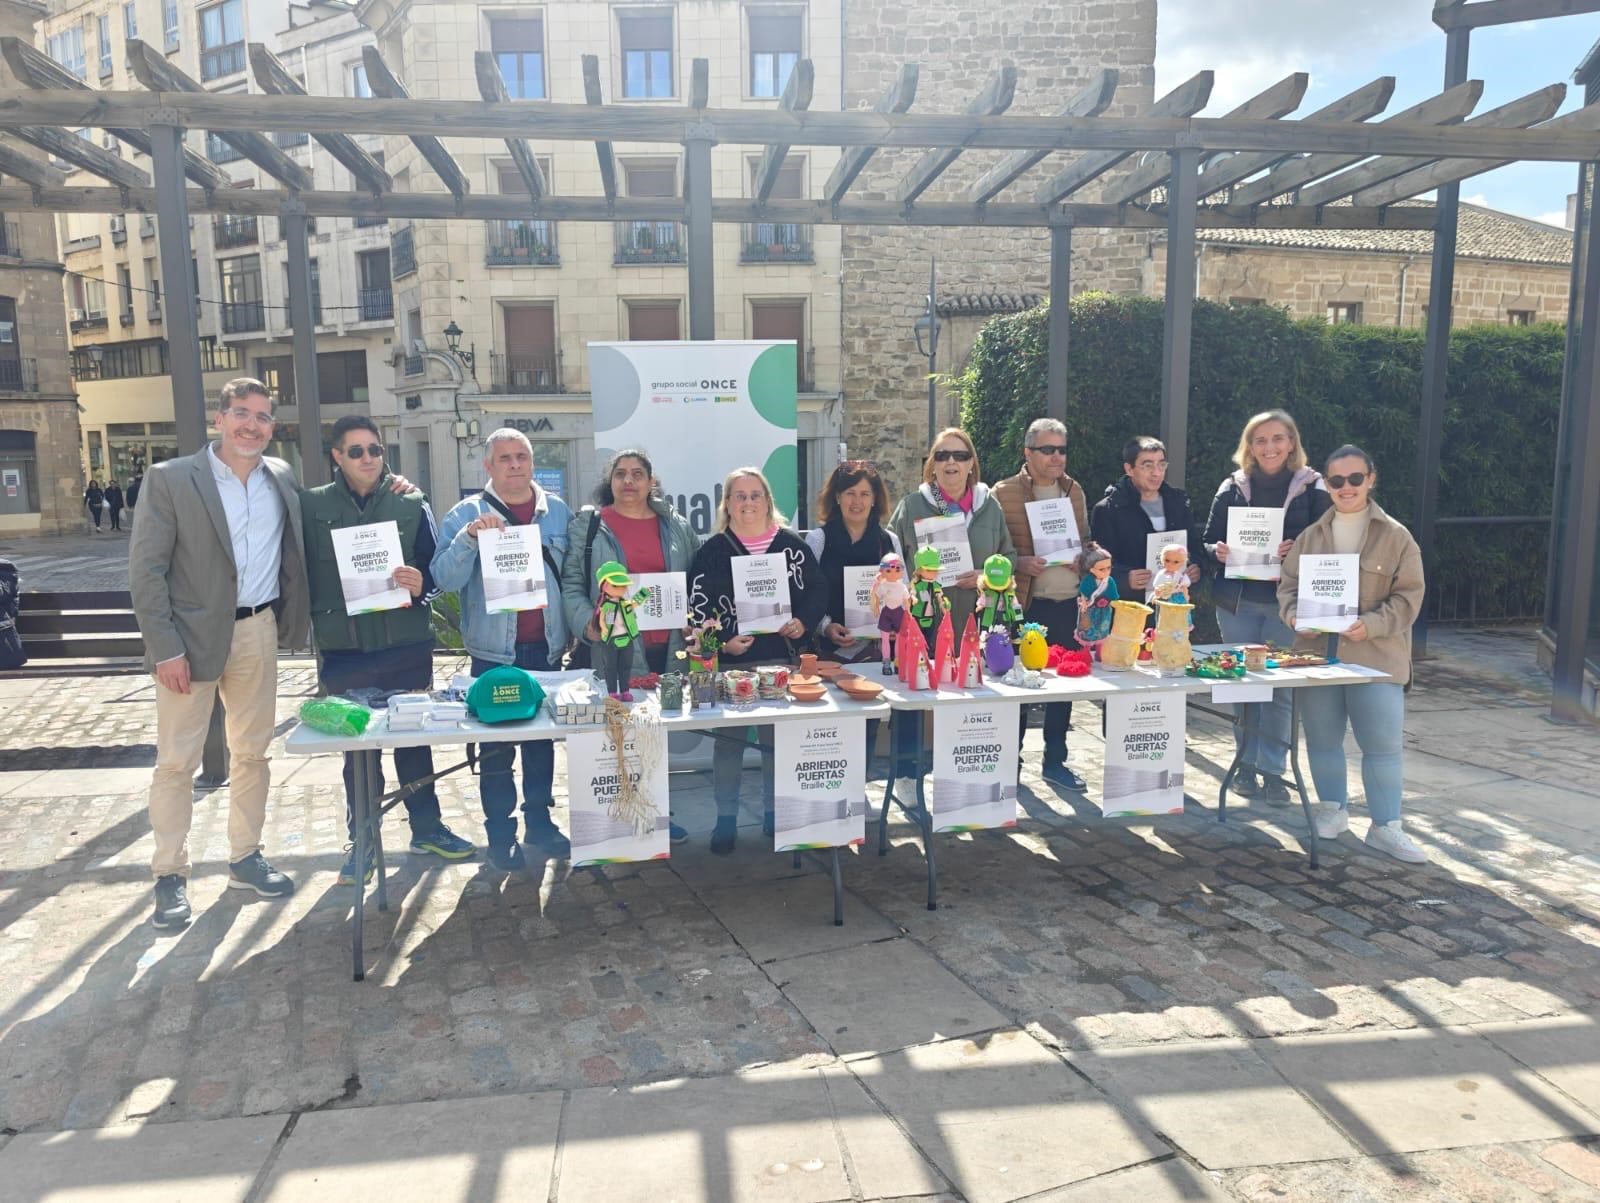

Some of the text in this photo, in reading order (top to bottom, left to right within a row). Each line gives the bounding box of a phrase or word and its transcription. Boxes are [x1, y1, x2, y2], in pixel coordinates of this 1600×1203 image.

[651, 379, 737, 390] grupo social ONCE
[504, 417, 554, 432] BBVA
[352, 550, 388, 562] ABRIENDO
[494, 552, 530, 561] ABRIENDO
[354, 558, 388, 568] PUERTAS
[496, 559, 528, 568] PUERTAS
[745, 578, 777, 587] ABRIENDO
[970, 716, 992, 724] ONCE
[813, 731, 837, 739] ONCE
[1123, 732, 1170, 743] ABRIENDO
[610, 744, 635, 752] OCE
[952, 744, 1002, 755] ABRIENDO
[1125, 742, 1167, 752] PUERTAS
[955, 754, 999, 765] PUERTAS
[1128, 752, 1149, 760] Braille
[795, 759, 847, 772] ABRIENDO
[958, 764, 996, 773] Braille 200
[798, 769, 845, 782] PUERTAS
[801, 780, 842, 790] Braille 200
